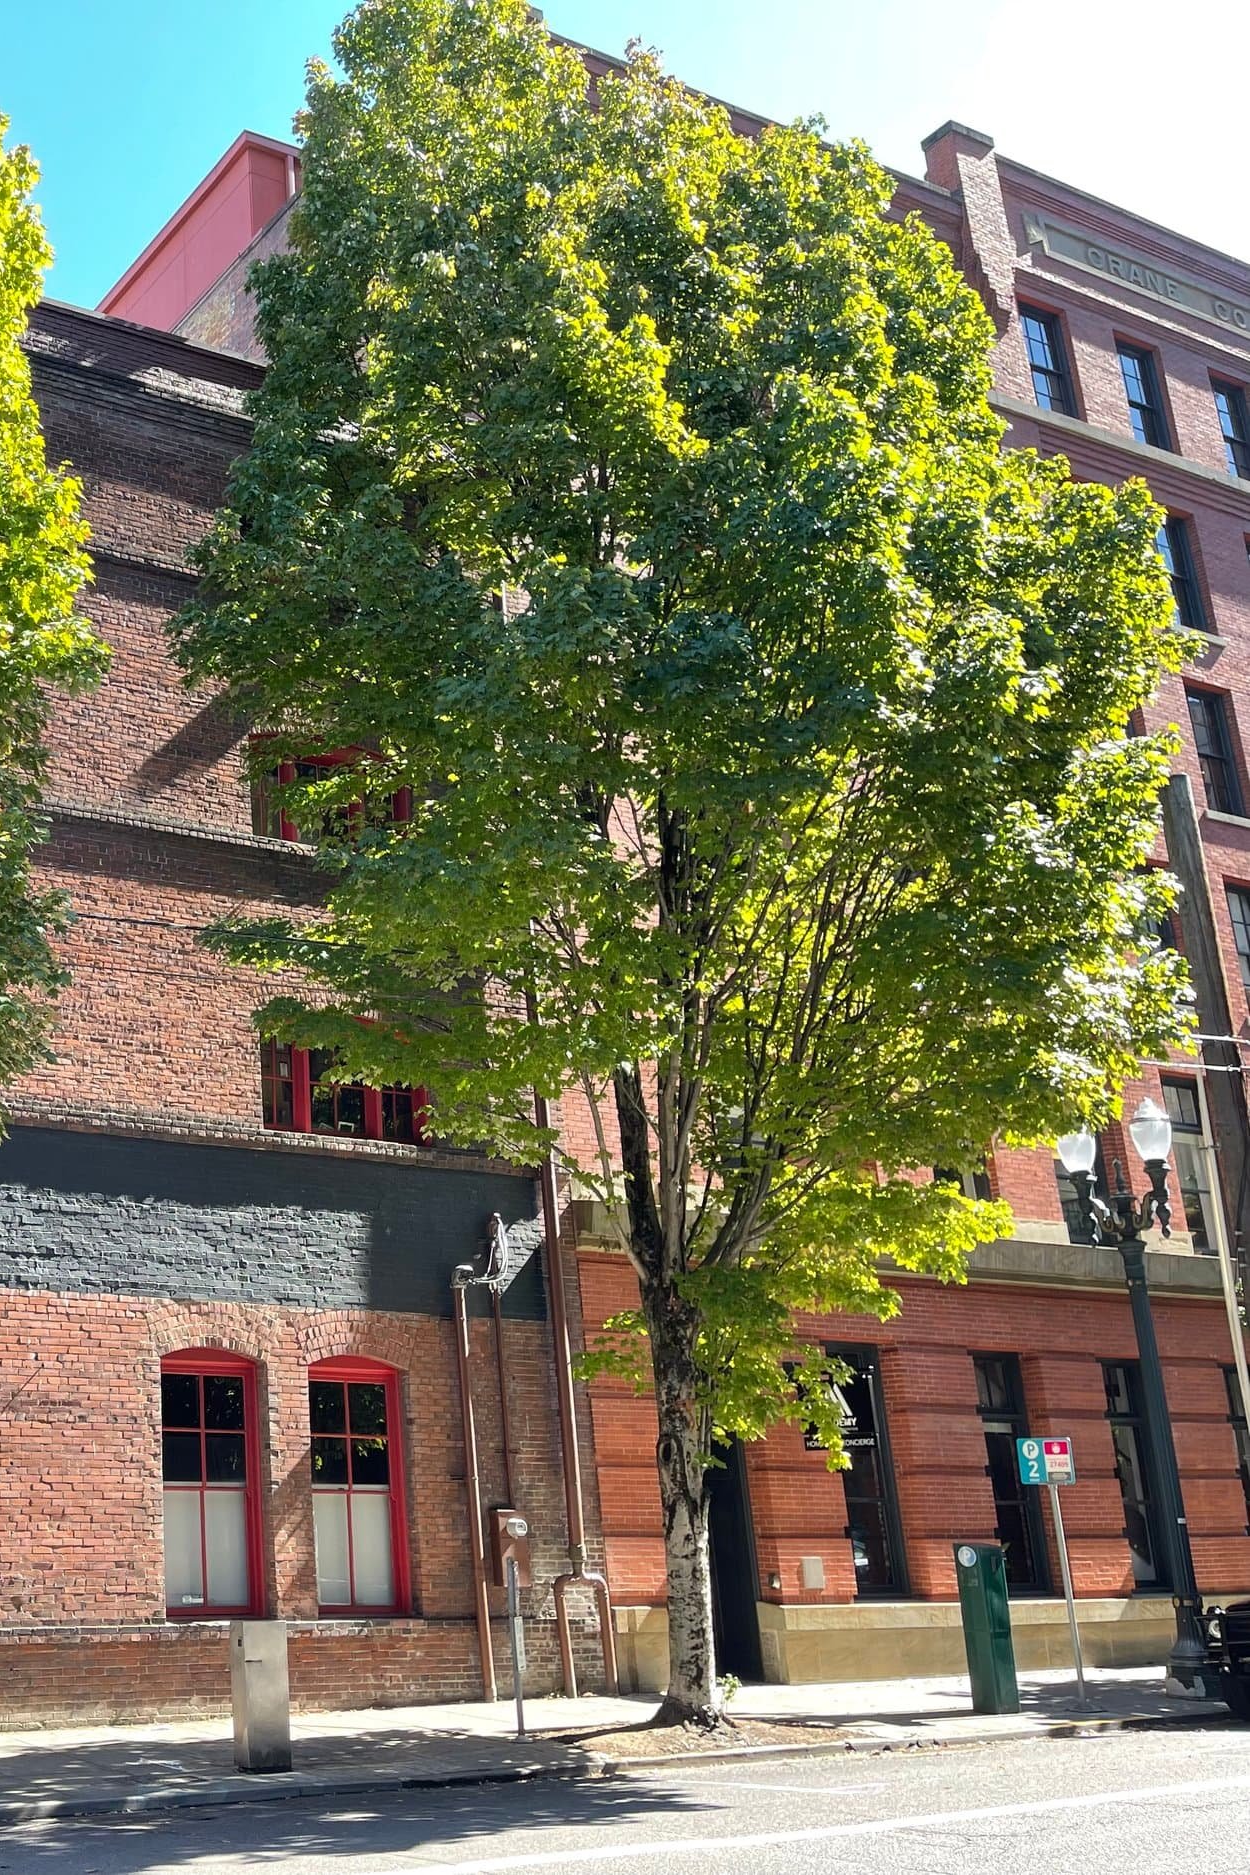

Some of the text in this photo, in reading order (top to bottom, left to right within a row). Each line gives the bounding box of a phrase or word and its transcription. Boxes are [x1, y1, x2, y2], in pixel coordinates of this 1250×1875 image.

[1086, 247, 1248, 329] CRANE CO
[845, 1438, 875, 1447] ONCIERGE
[1027, 1443, 1035, 1457] P
[1028, 1461, 1040, 1478] 2
